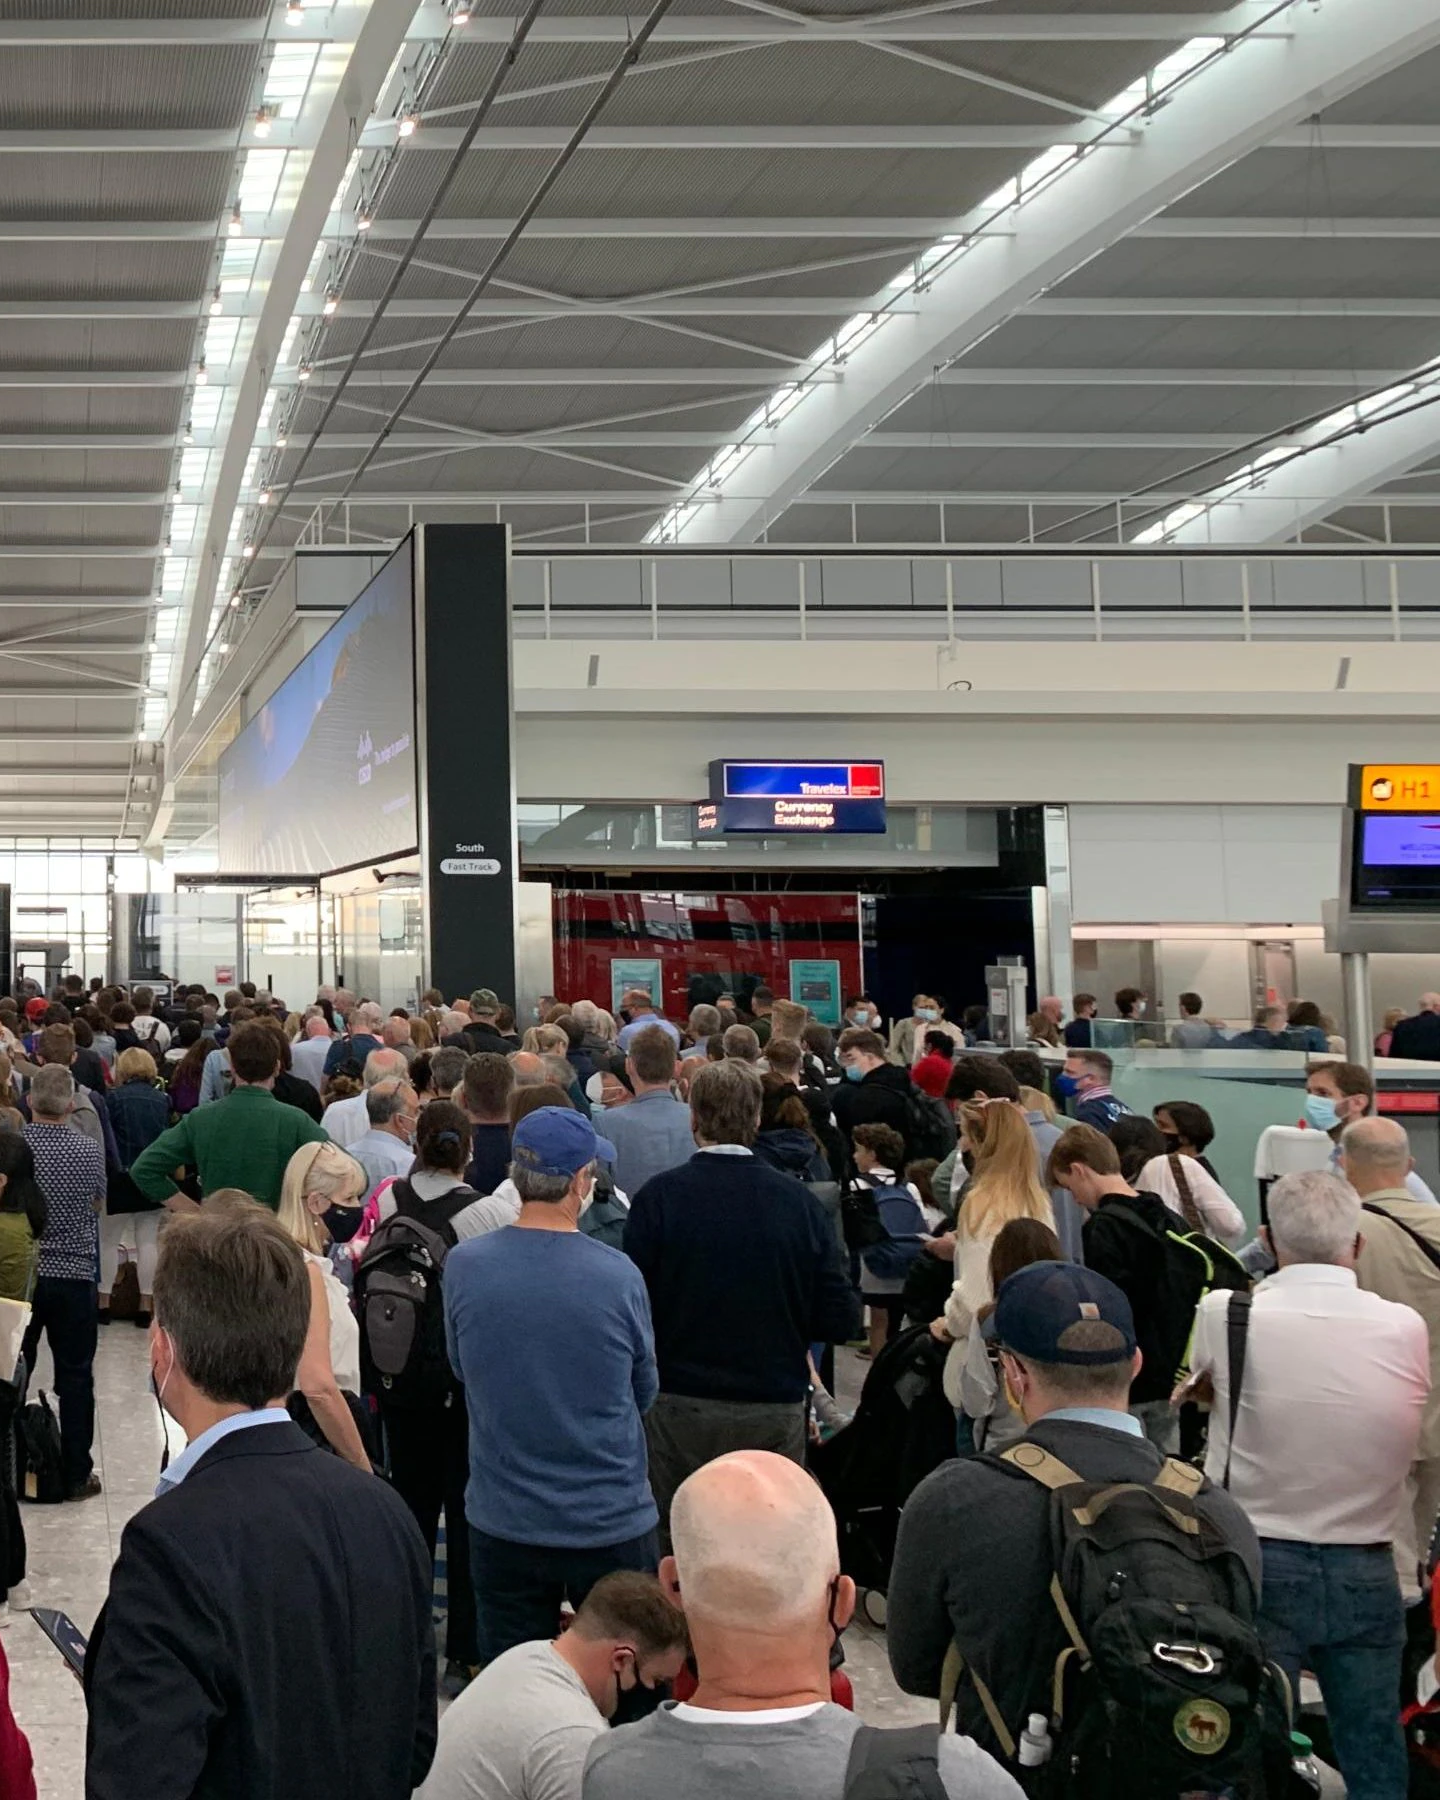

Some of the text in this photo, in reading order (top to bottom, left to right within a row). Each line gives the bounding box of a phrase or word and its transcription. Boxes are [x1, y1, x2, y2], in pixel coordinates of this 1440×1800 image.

[800, 782, 847, 795] Travelex
[1401, 780, 1430, 800] H1
[774, 801, 834, 815] Currency
[774, 814, 835, 828] Exchange
[455, 843, 485, 853] South
[447, 862, 493, 871] Fast Track
